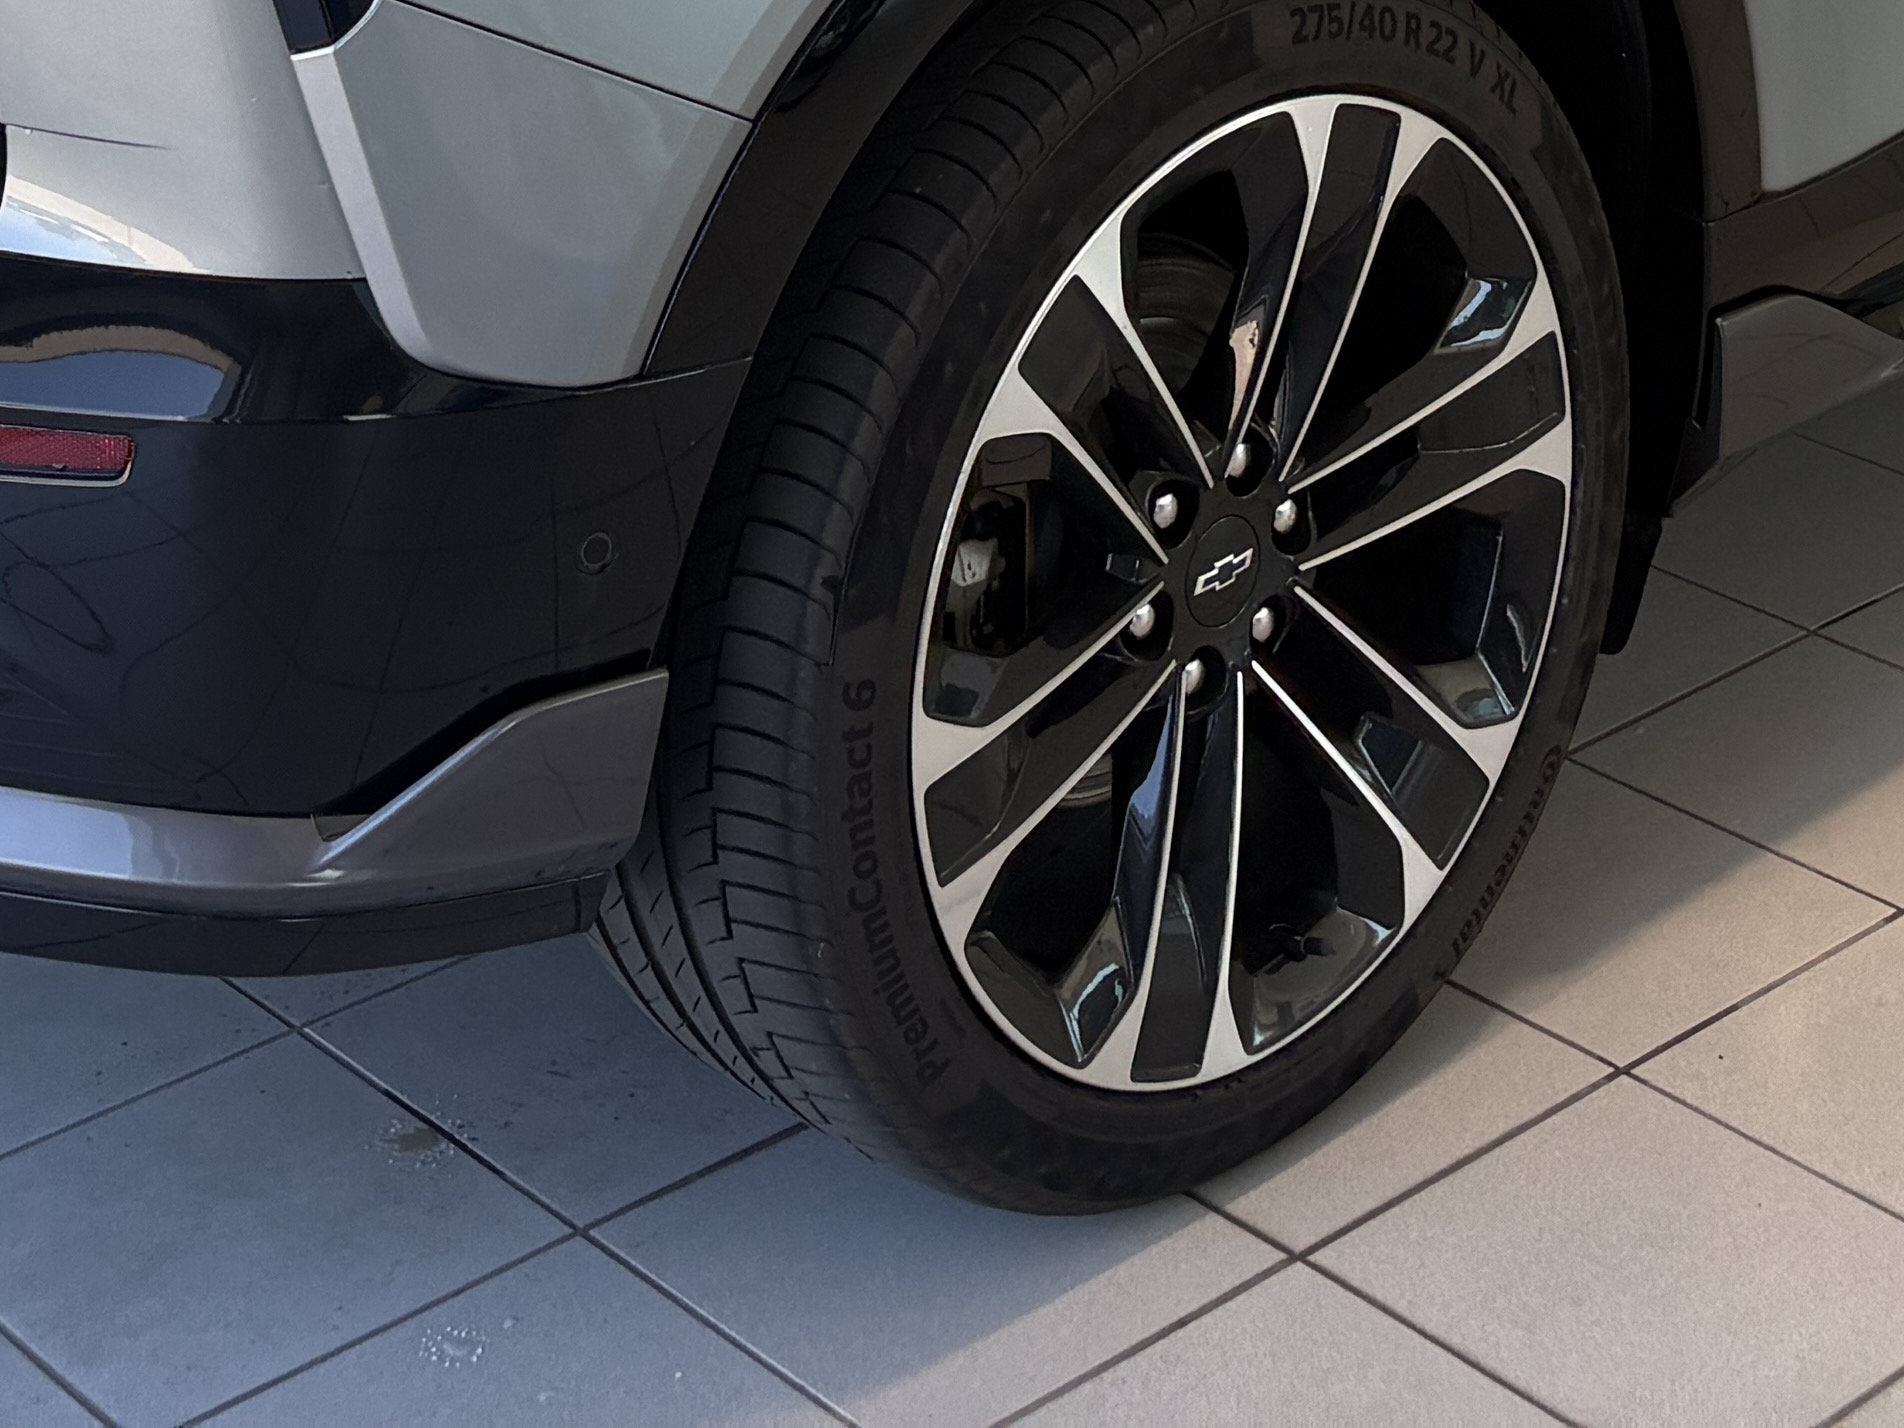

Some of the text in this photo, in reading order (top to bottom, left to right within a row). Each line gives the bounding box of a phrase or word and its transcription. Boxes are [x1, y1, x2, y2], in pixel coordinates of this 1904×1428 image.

[1290, 1, 1397, 45] 275/40
[1469, 40, 1486, 78] V
[1490, 61, 1518, 117] XL
[841, 678, 952, 1088] PremiumContact 6
